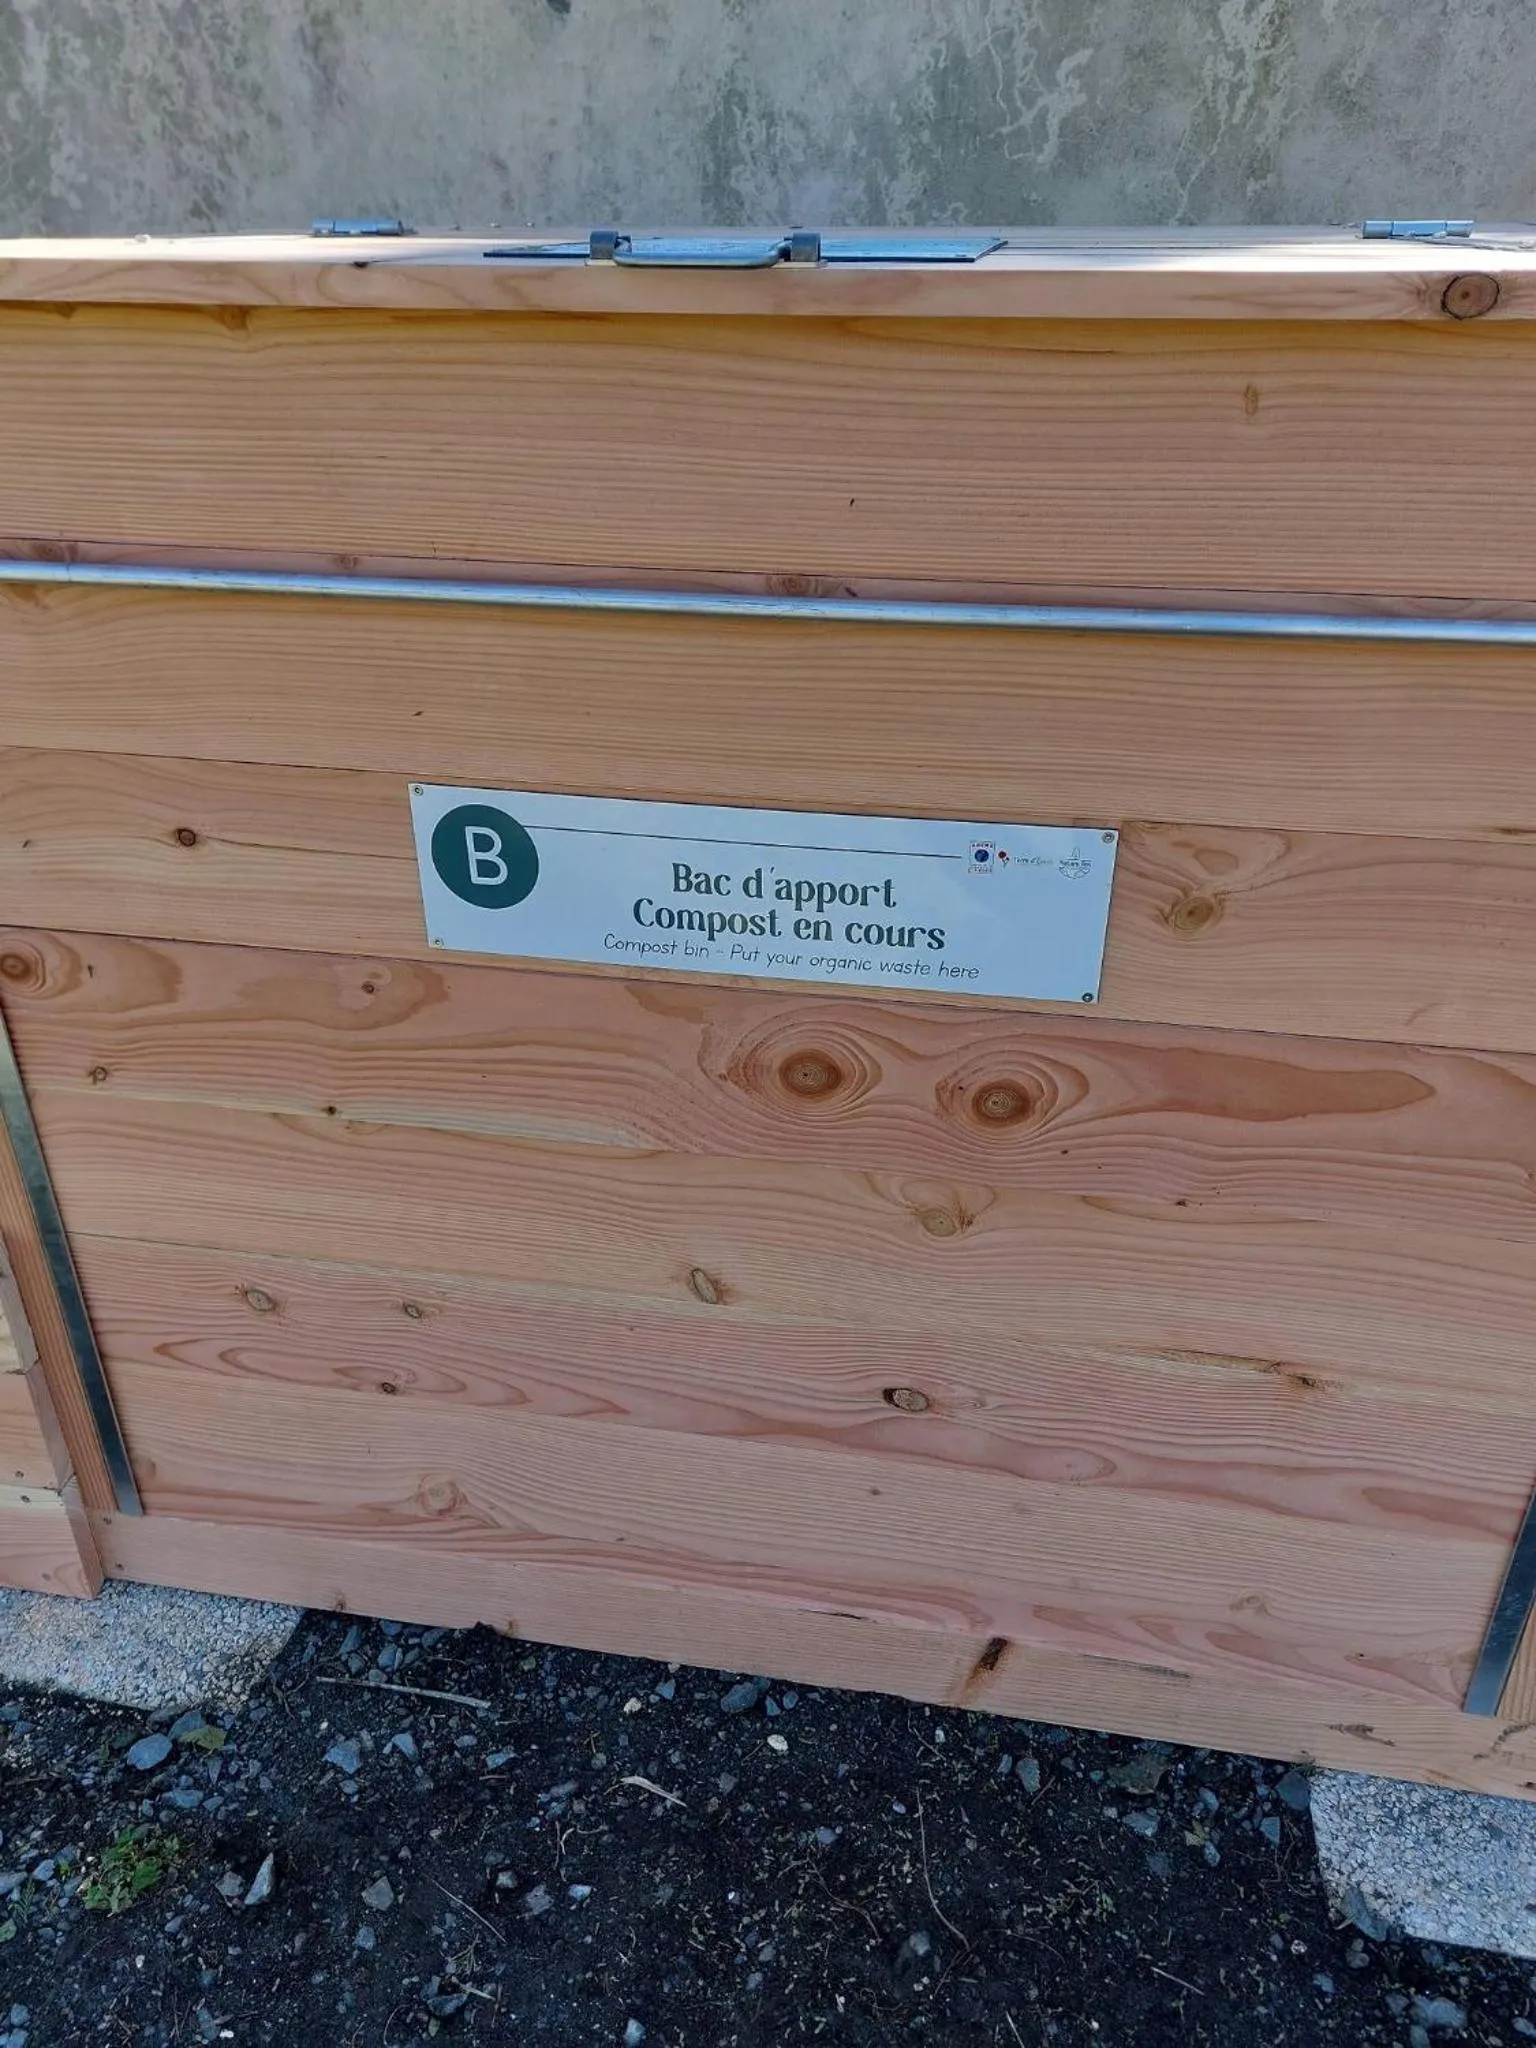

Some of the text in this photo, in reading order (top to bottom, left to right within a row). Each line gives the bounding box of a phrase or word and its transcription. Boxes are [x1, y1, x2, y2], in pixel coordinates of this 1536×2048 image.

[465, 825, 508, 885] B
[671, 862, 897, 912] Bac d'apport
[633, 897, 946, 950] Compost en cours
[603, 933, 678, 957] Compost
[684, 939, 709, 958] bin
[730, 943, 759, 962] Put
[766, 951, 802, 968] your
[810, 955, 873, 974] organic
[880, 959, 931, 976] waste
[938, 960, 980, 979] here
